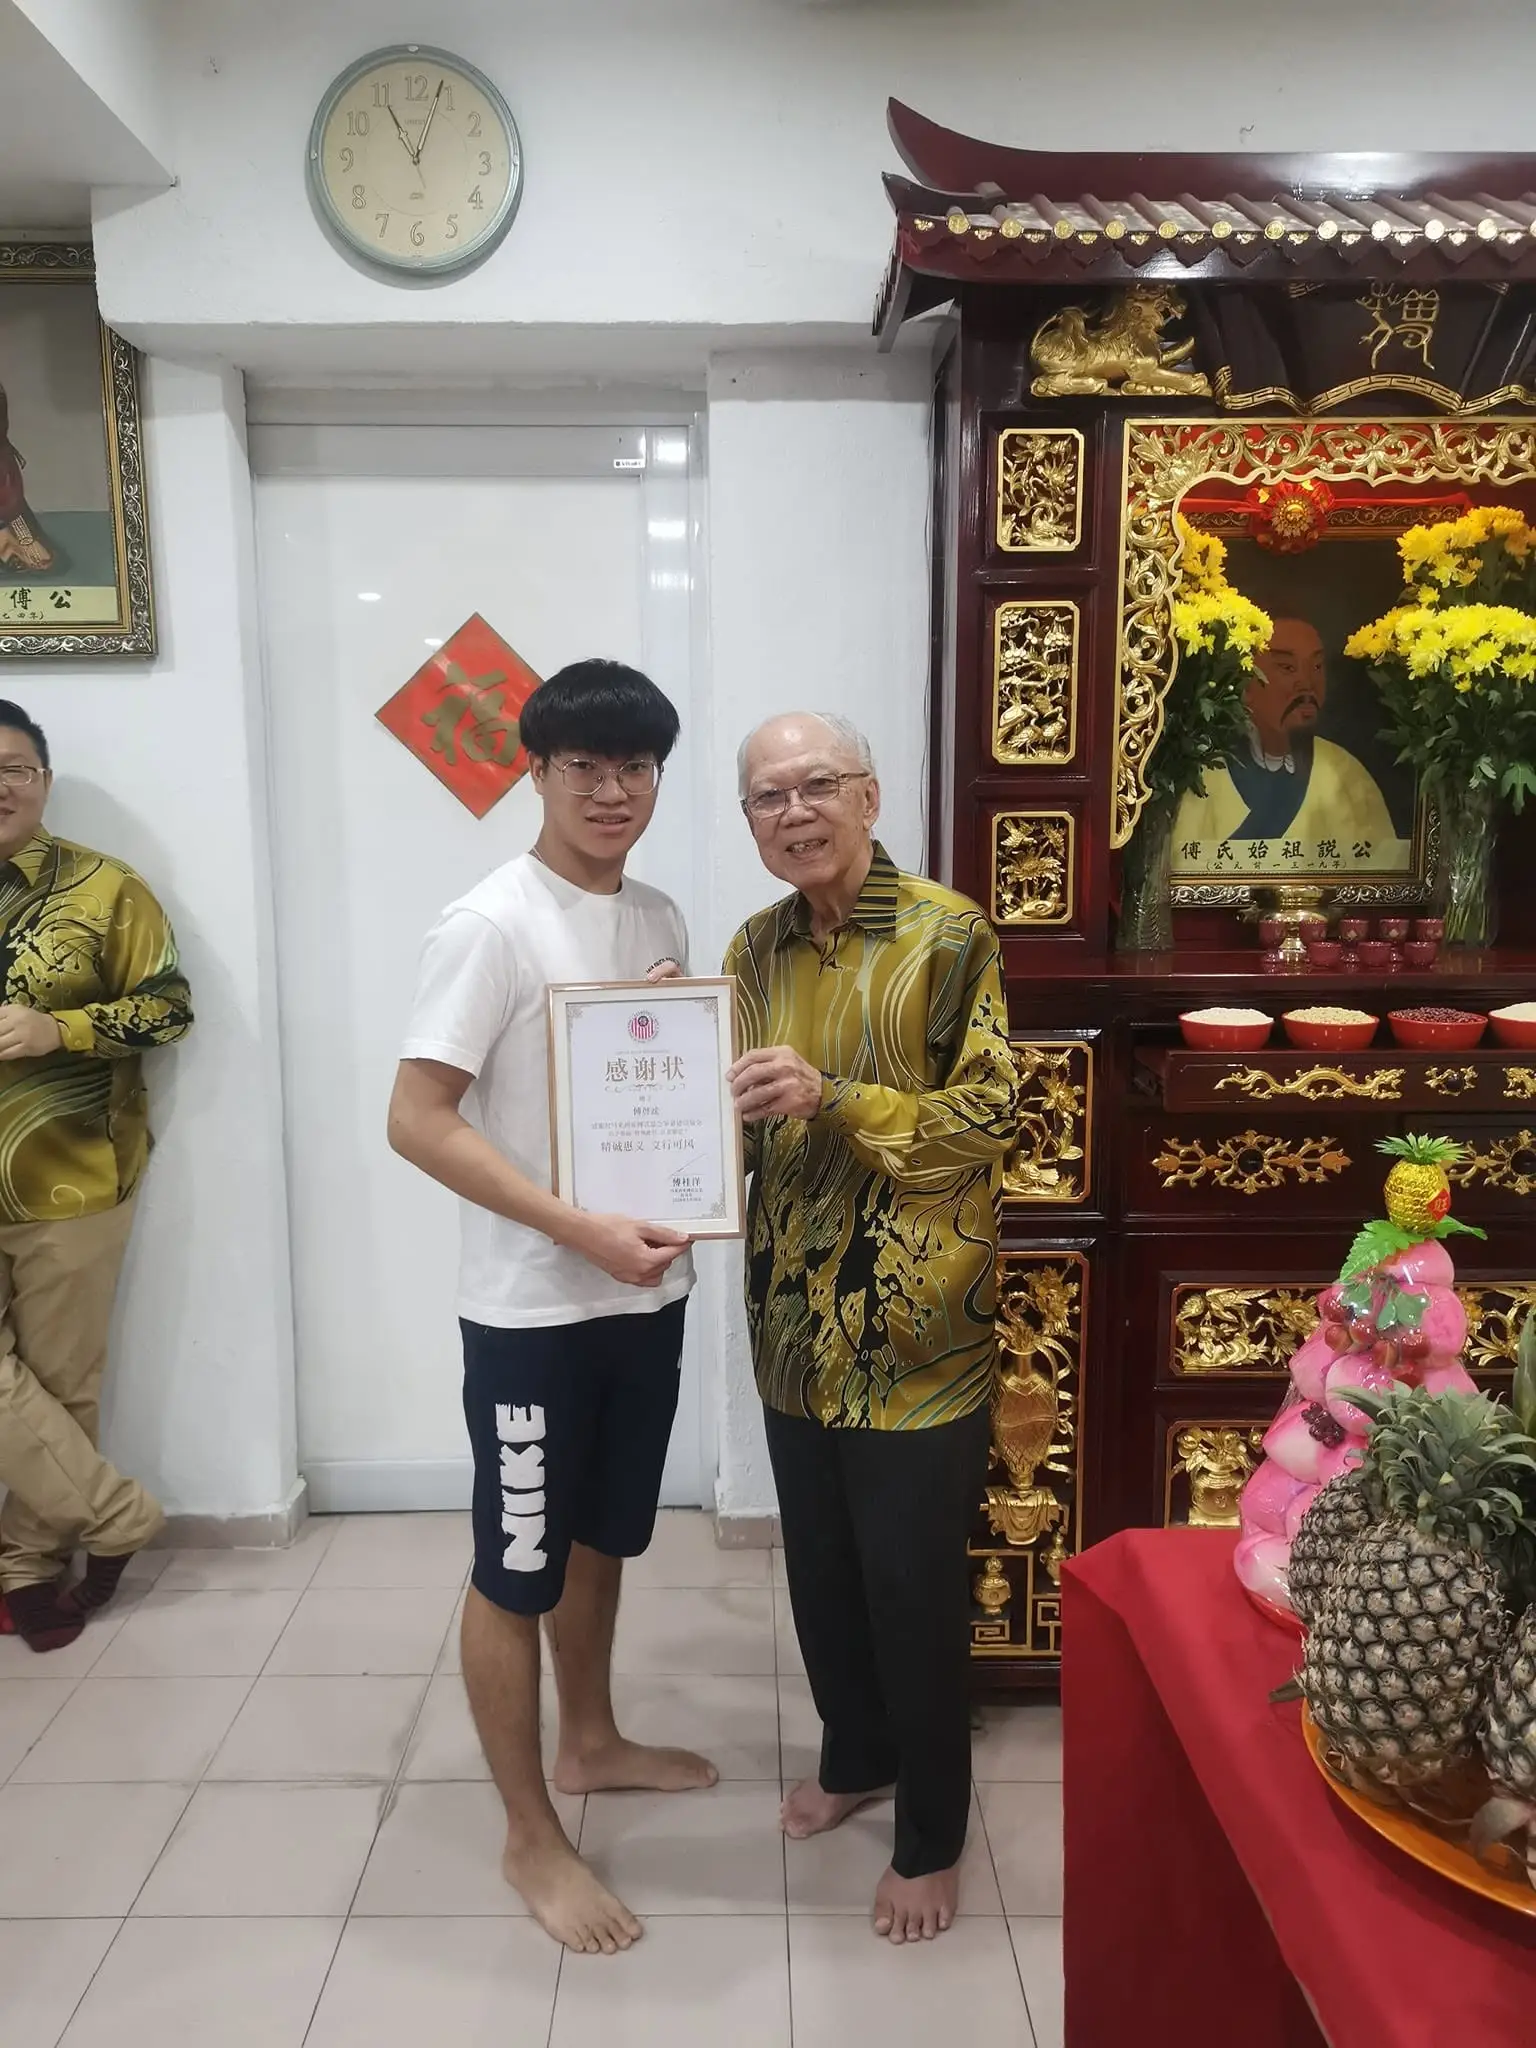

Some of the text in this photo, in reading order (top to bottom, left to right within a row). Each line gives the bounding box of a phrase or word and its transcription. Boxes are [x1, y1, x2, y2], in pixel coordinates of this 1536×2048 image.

[371, 82, 393, 108] 11
[404, 75, 429, 101] 12
[444, 85, 456, 111] 1
[346, 111, 370, 136] 10
[467, 111, 482, 137] 2
[340, 147, 354, 173] 9
[478, 151, 492, 176] 3
[352, 184, 367, 209] 8
[467, 184, 483, 210] 4
[375, 213, 389, 238] 7
[410, 221, 425, 246] 6
[445, 214, 459, 239] 5
[420, 661, 521, 767] 福
[605, 1056, 685, 1082] 感谢状
[496, 1404, 548, 1572] NIKE
